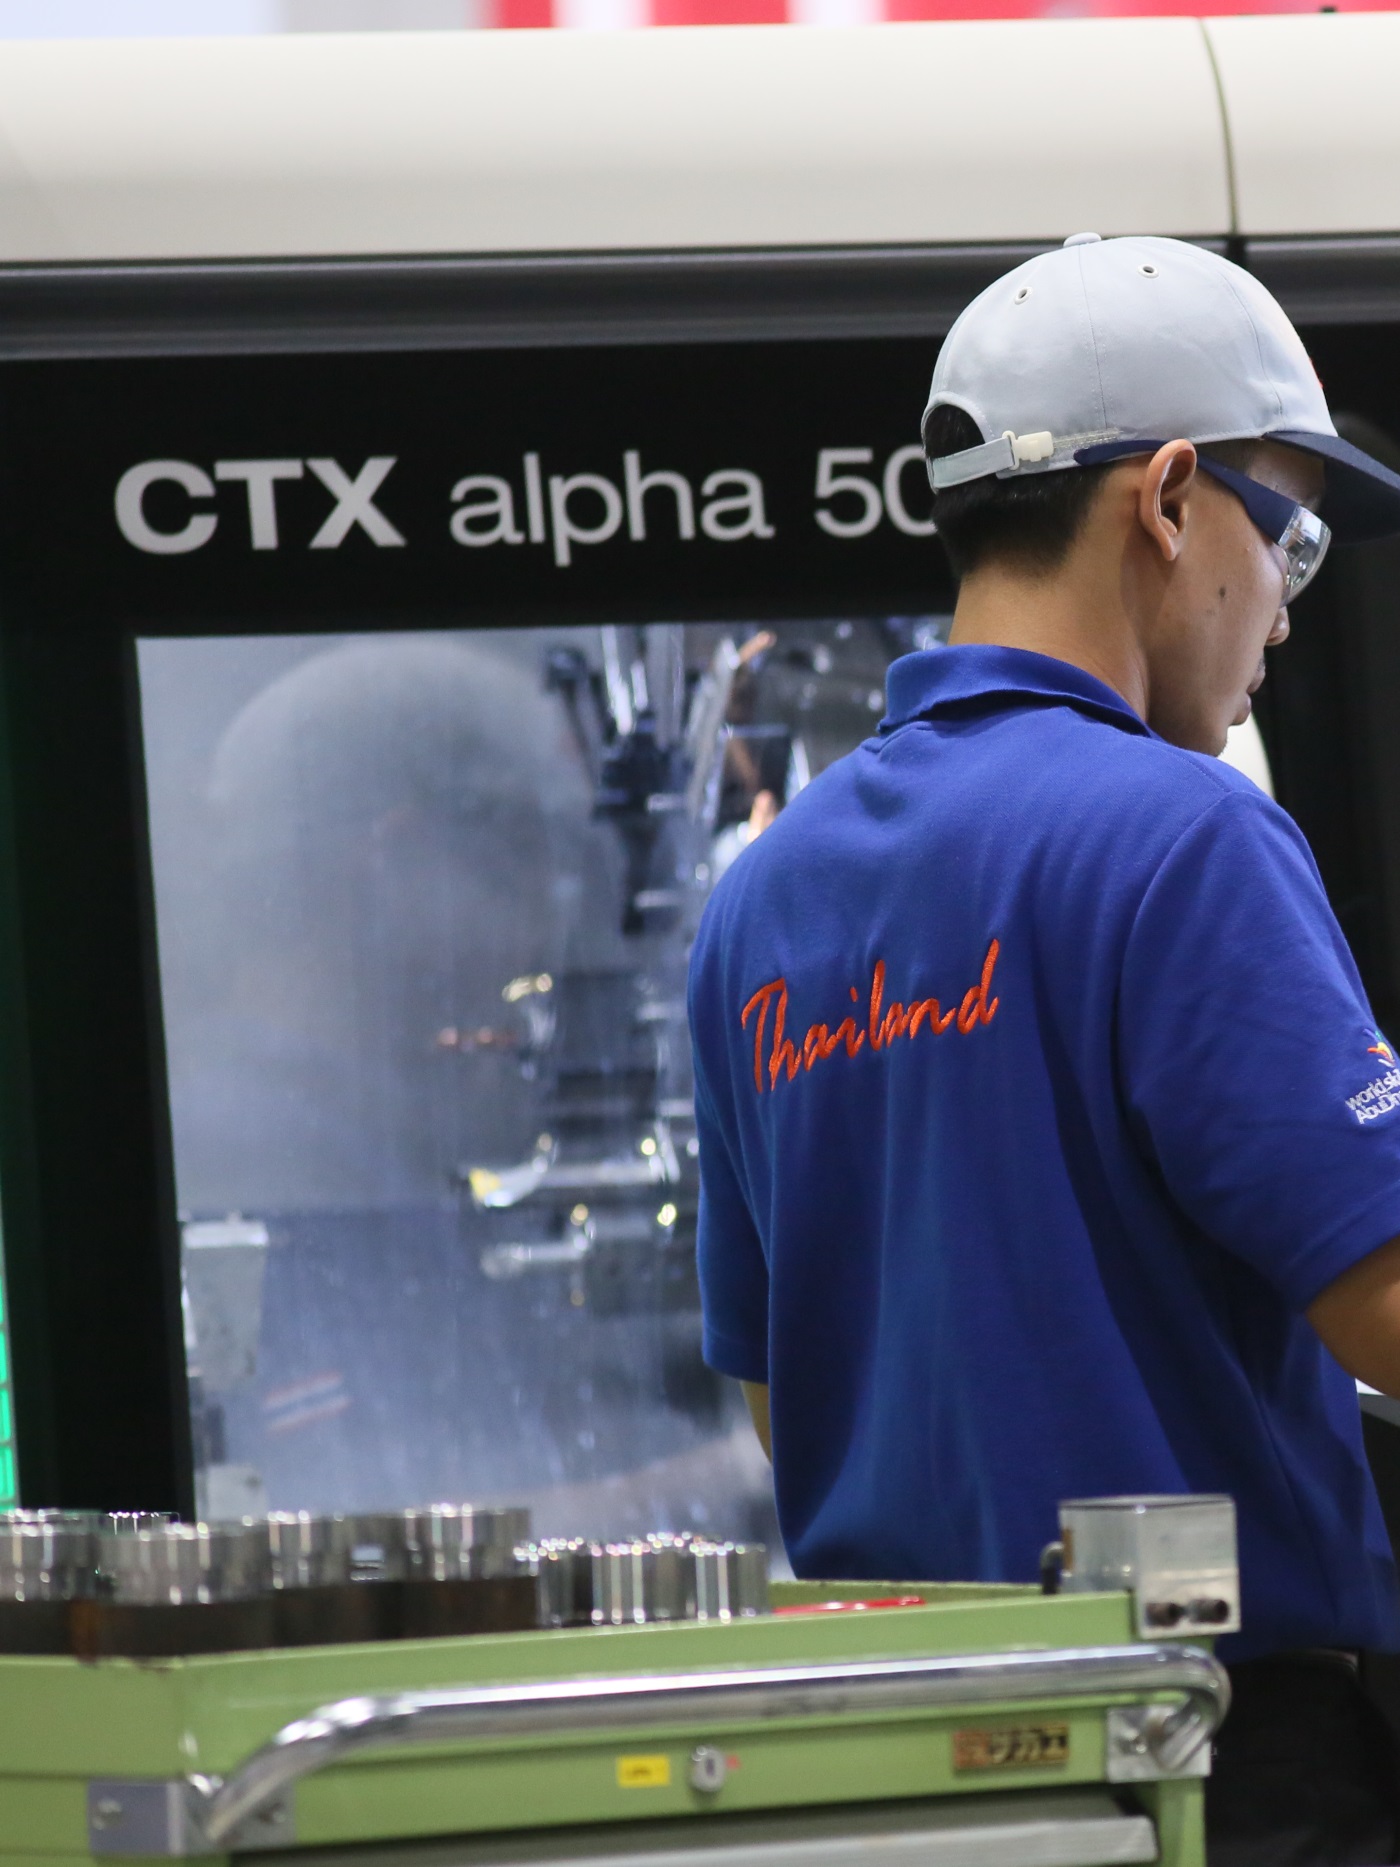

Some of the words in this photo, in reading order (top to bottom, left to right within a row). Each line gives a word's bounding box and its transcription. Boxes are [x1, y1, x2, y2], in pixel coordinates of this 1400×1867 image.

[113, 456, 407, 555] CTX
[448, 449, 776, 568] alpha
[813, 443, 938, 539] 50
[741, 938, 1000, 1094] Thailand
